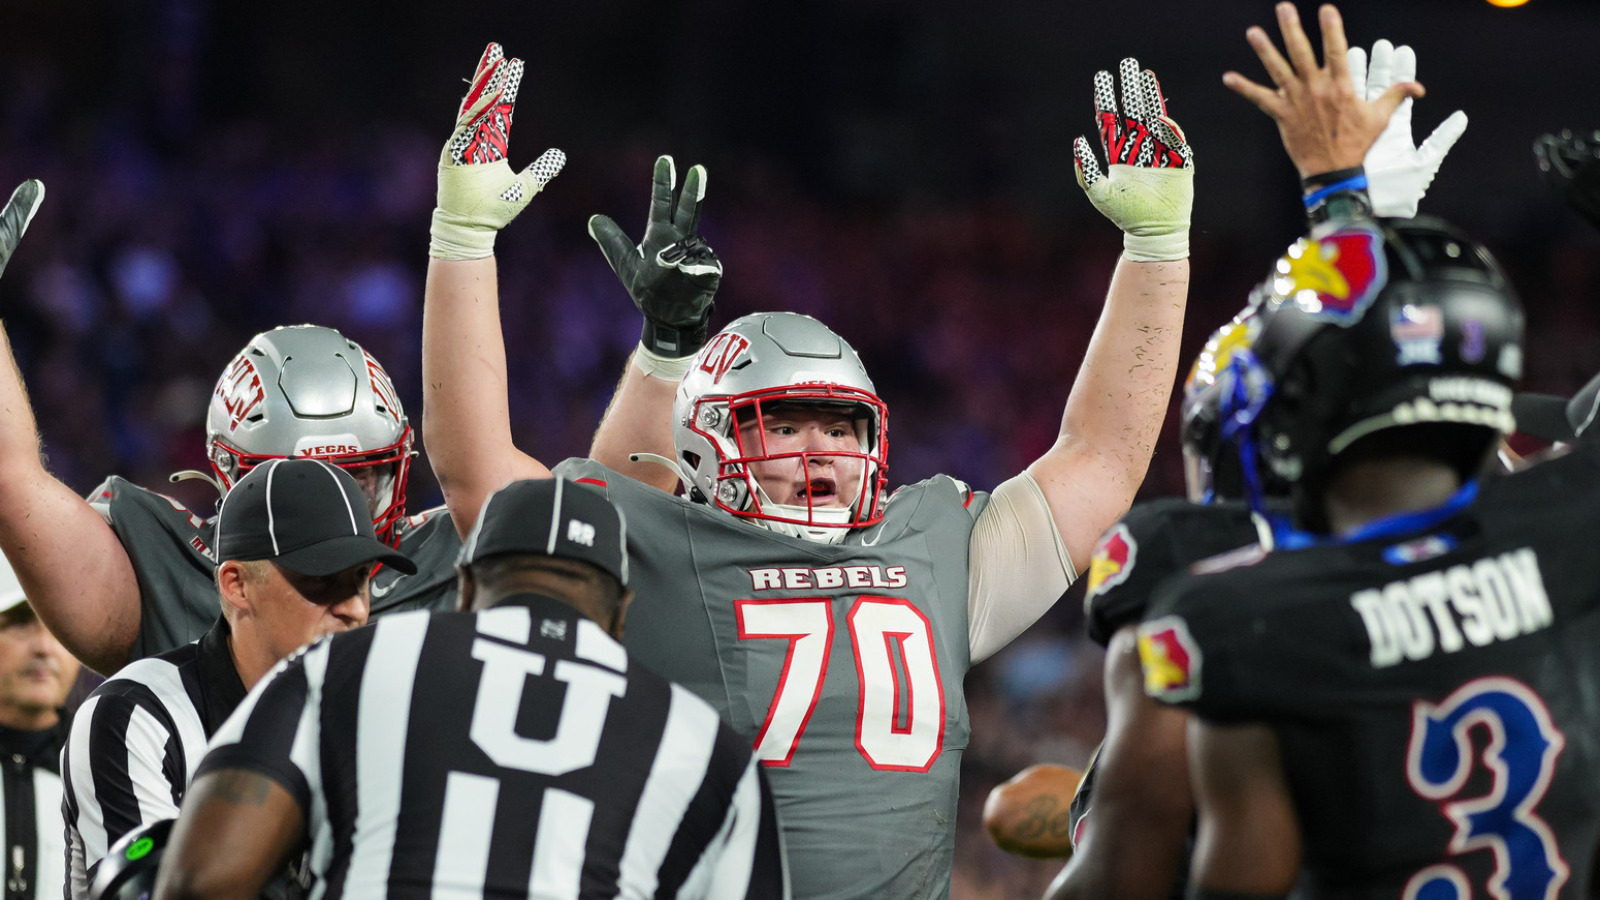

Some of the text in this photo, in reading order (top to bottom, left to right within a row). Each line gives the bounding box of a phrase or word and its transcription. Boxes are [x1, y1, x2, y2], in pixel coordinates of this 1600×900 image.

[301, 445, 358, 456] VEGAS
[567, 519, 595, 547] RR
[748, 566, 907, 591] REBELS
[1350, 547, 1554, 669] DOTSON
[469, 637, 628, 776] U
[733, 595, 946, 773] 70
[1402, 676, 1571, 900] 3
